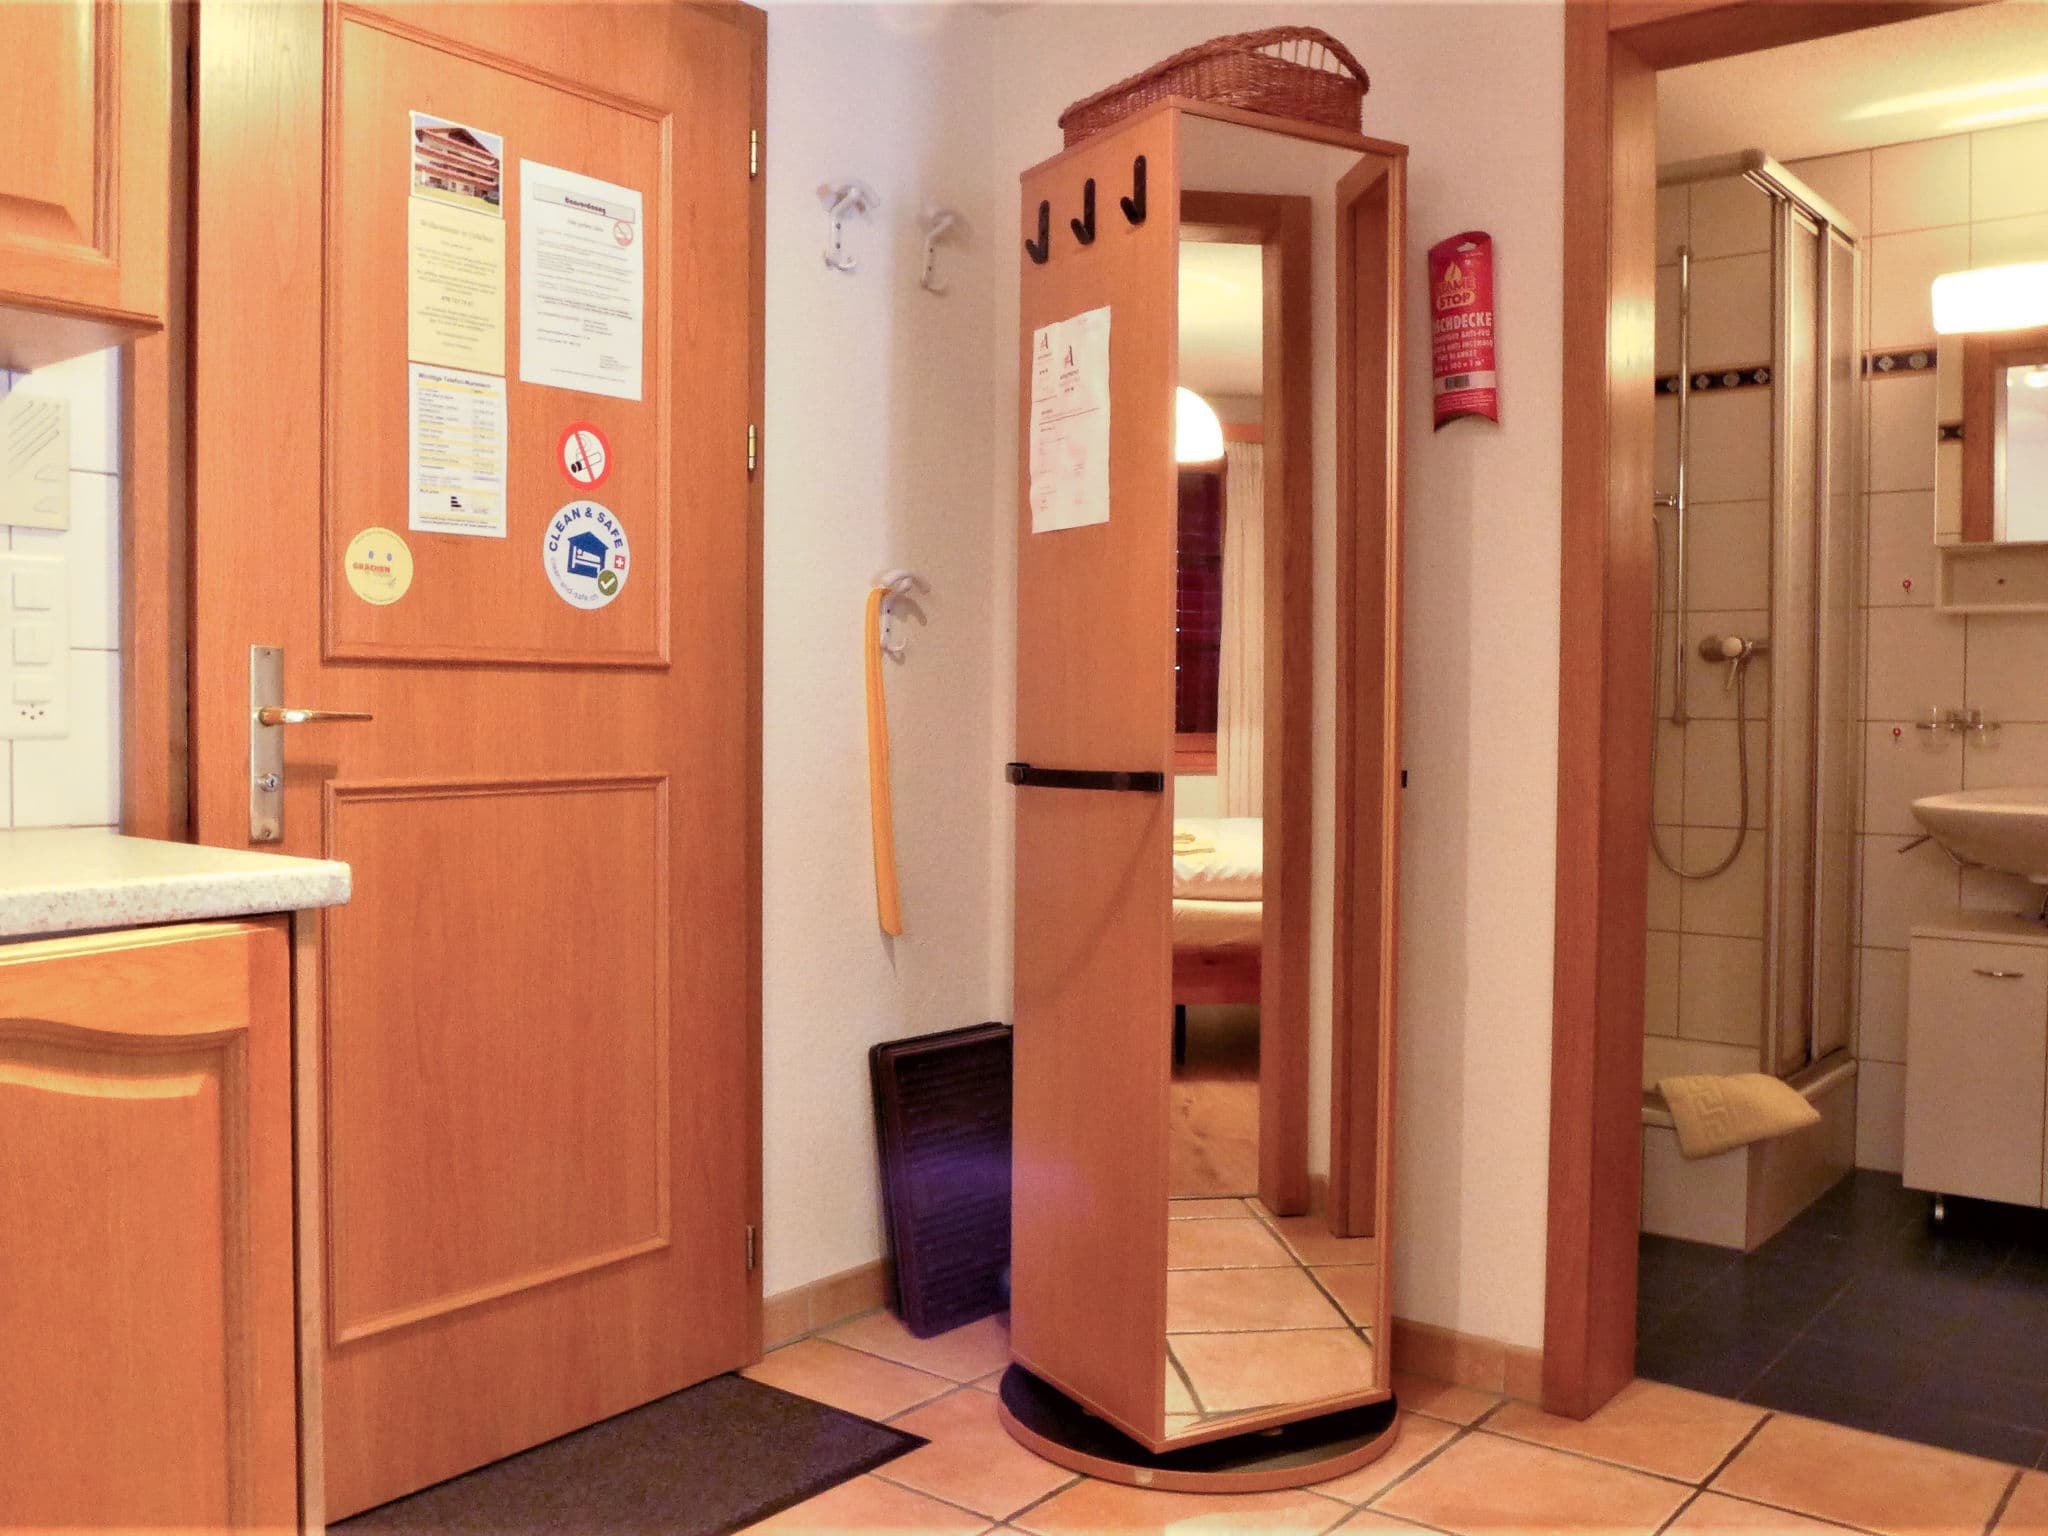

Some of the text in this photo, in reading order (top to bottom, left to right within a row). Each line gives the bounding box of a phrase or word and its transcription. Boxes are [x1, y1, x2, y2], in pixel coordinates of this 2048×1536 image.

[549, 506, 624, 552] CLEAN & SAFE
